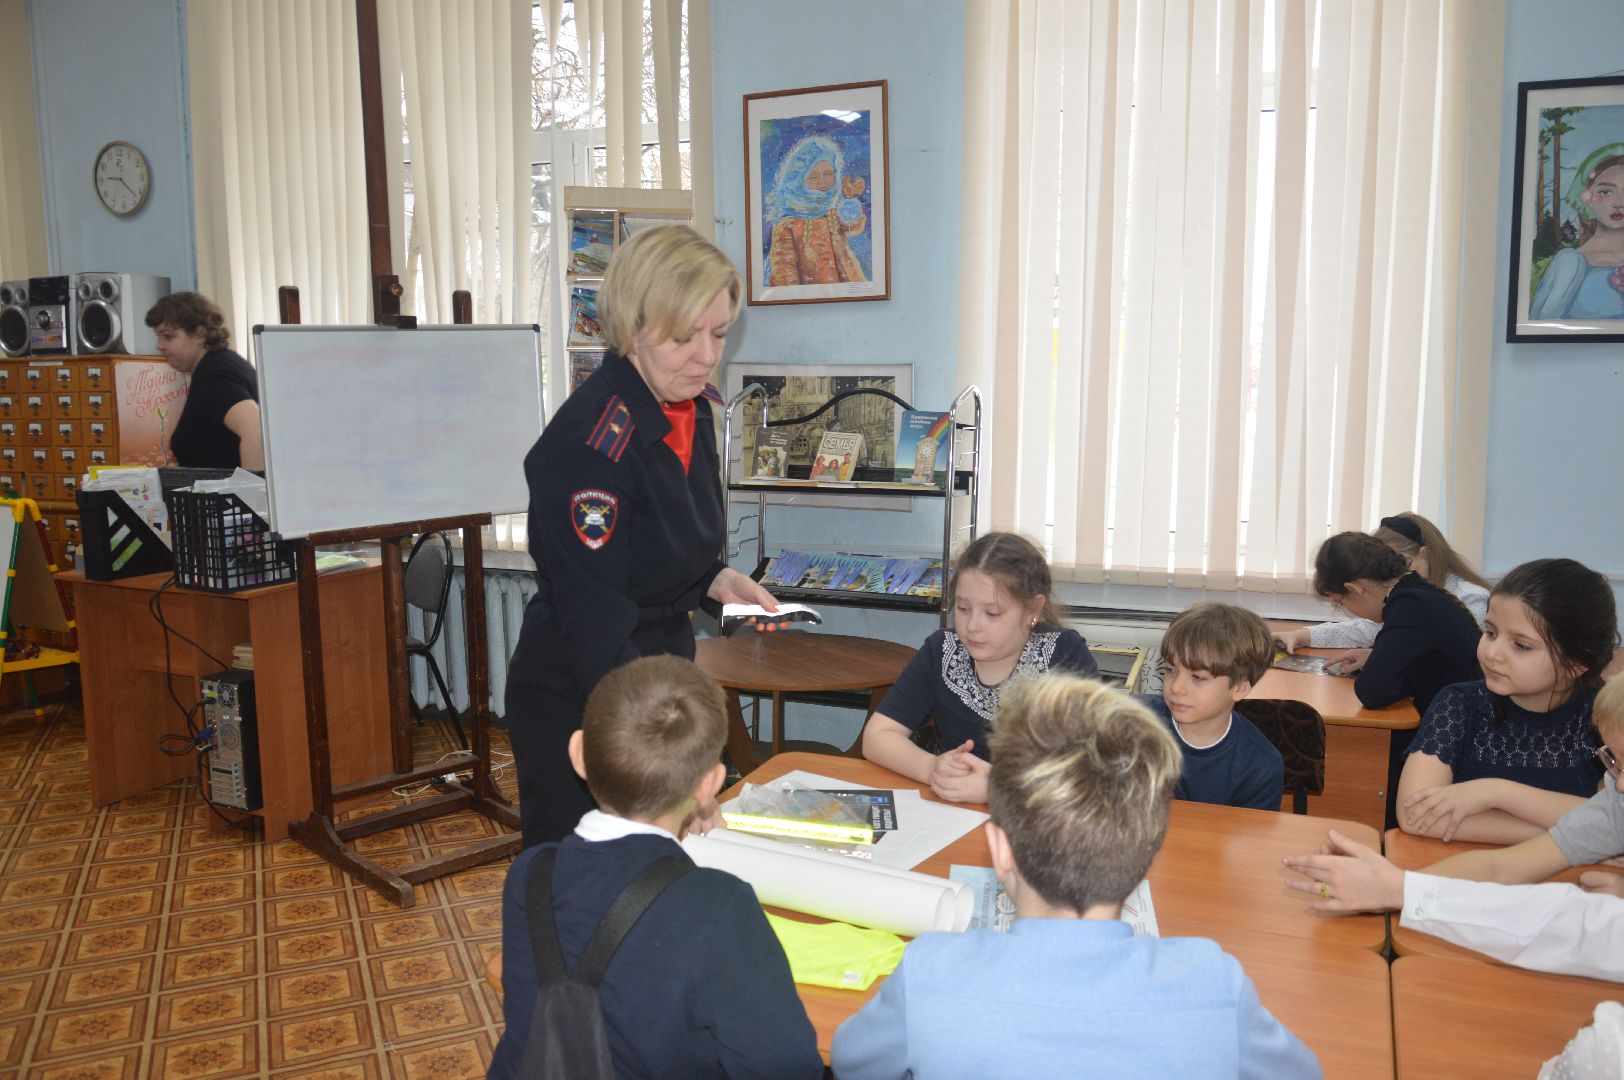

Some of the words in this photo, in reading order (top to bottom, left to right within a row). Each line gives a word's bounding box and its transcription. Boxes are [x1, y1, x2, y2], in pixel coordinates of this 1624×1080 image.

[127, 365, 177, 400] Тайна
[126, 383, 190, 417] Красот
[823, 438, 856, 450] СЕМЬЯ
[574, 492, 615, 504] ПОЛИЦИЯ
